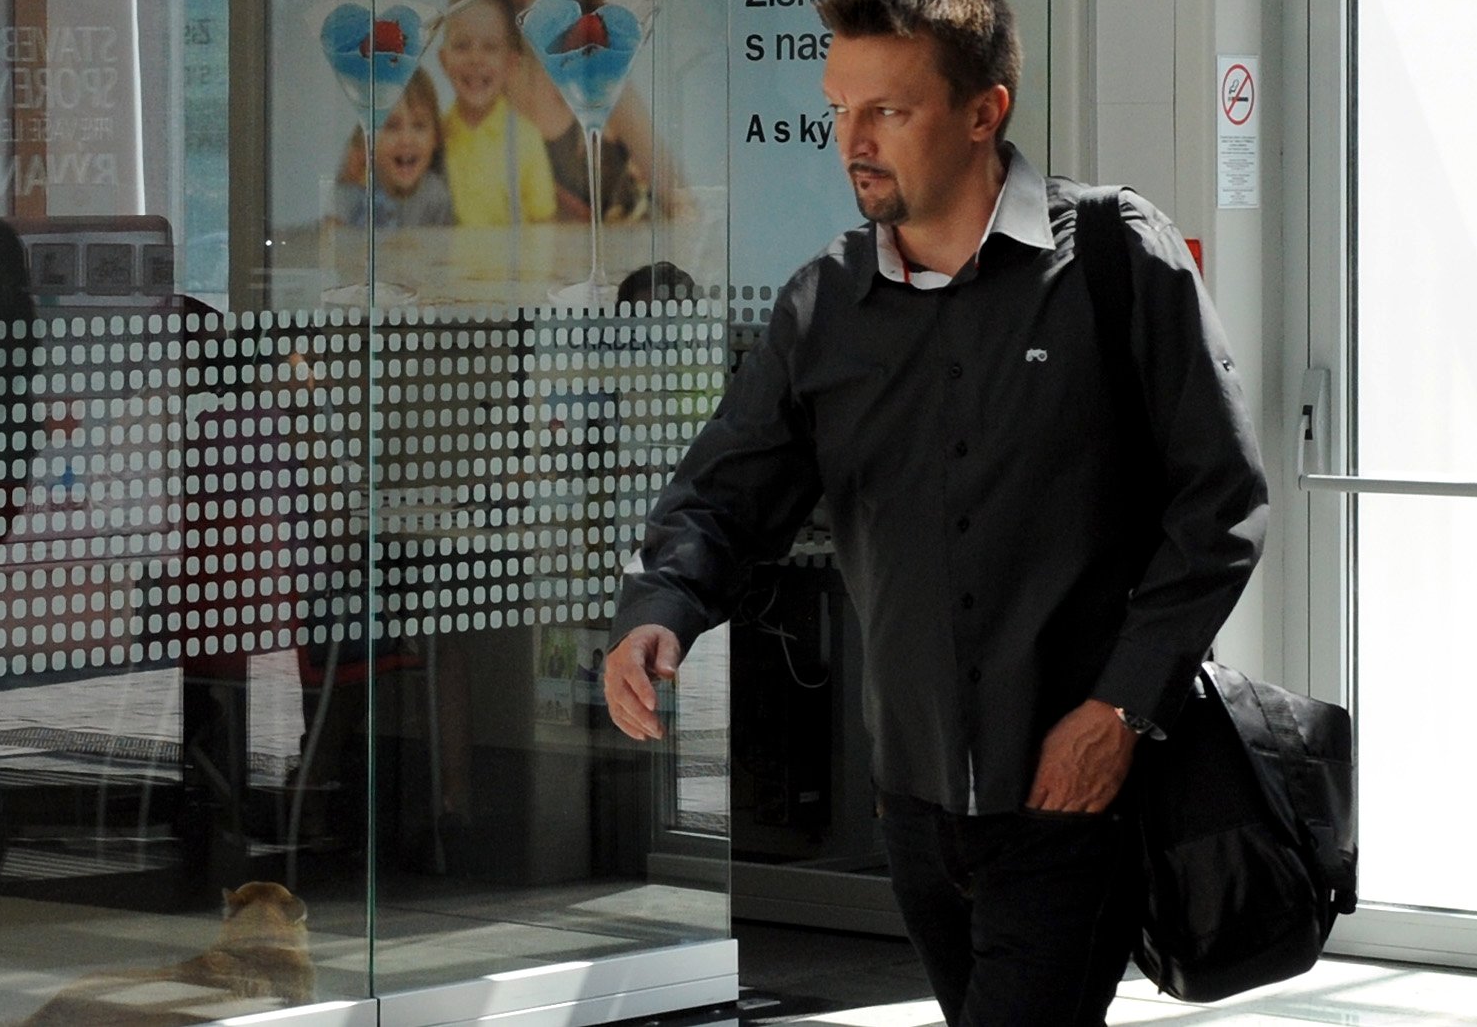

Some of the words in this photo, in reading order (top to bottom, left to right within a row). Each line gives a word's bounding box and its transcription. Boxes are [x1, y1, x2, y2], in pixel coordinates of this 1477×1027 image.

[745, 34, 765, 61] s
[776, 33, 834, 61] nas
[746, 114, 766, 143] A
[774, 121, 791, 144] s
[800, 112, 838, 150] ký
